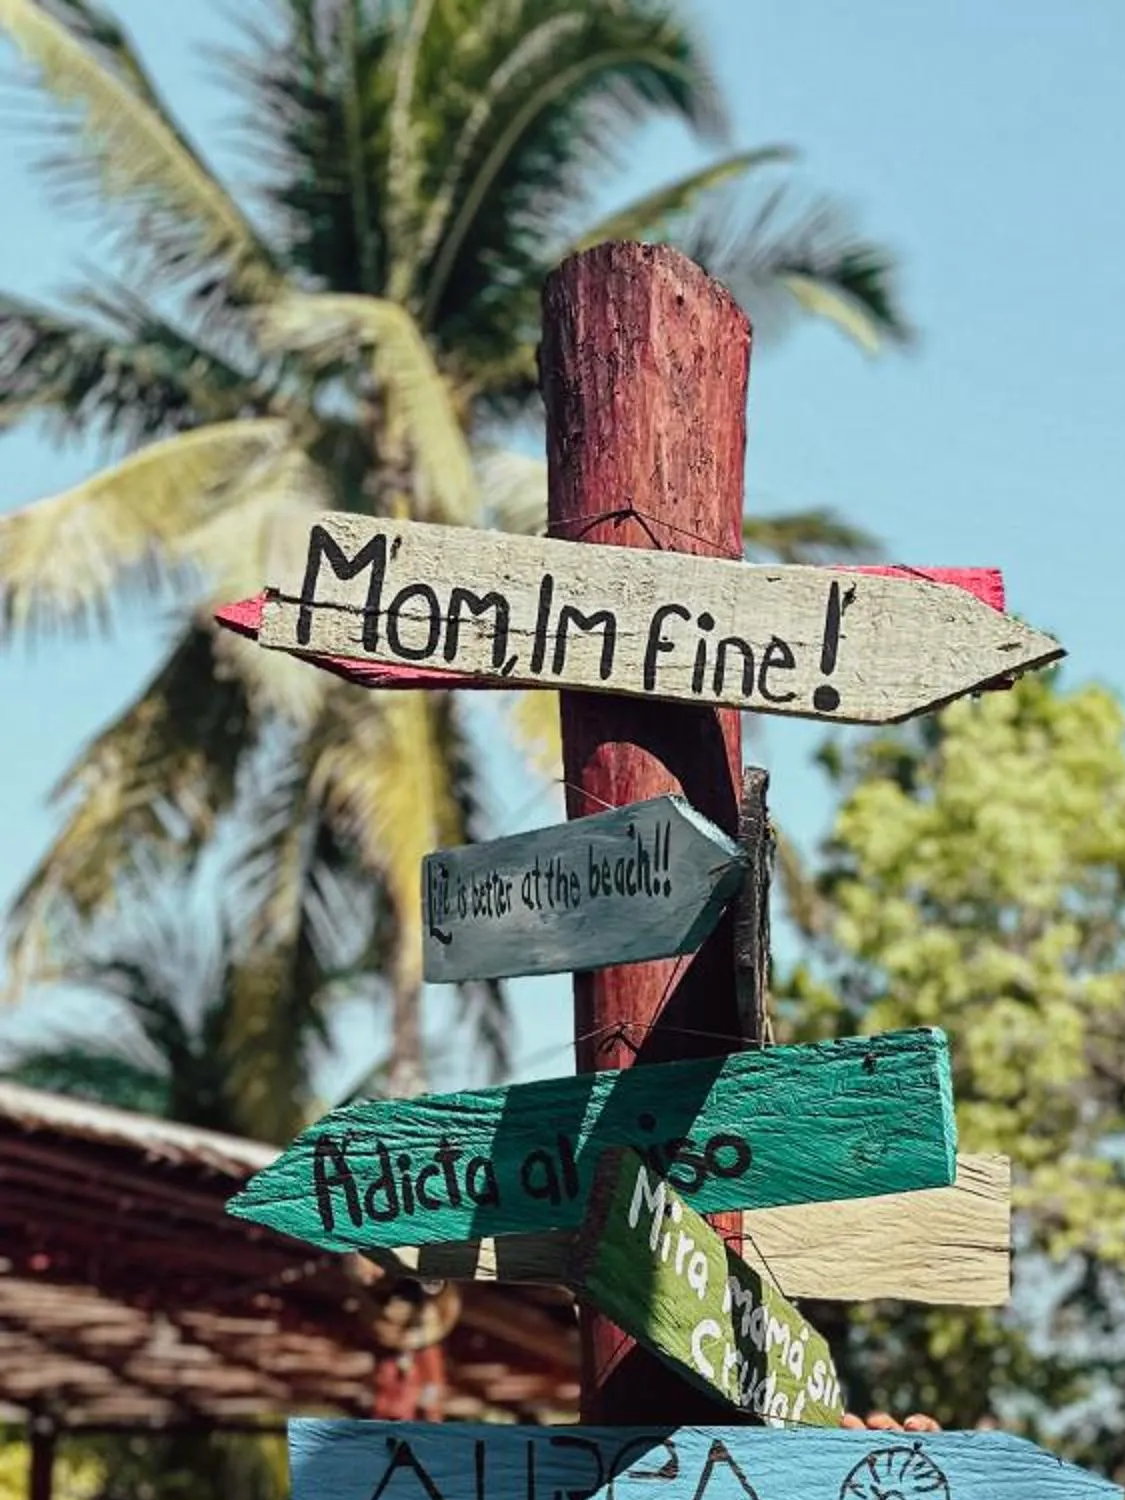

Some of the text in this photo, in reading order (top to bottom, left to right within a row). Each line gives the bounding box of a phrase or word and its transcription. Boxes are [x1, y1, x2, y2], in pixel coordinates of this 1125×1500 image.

[471, 869, 513, 919] better
[521, 855, 543, 911] at
[546, 856, 581, 909] the
[313, 1112, 753, 1232] Adicta al iso
[628, 1165, 709, 1300] Mira
